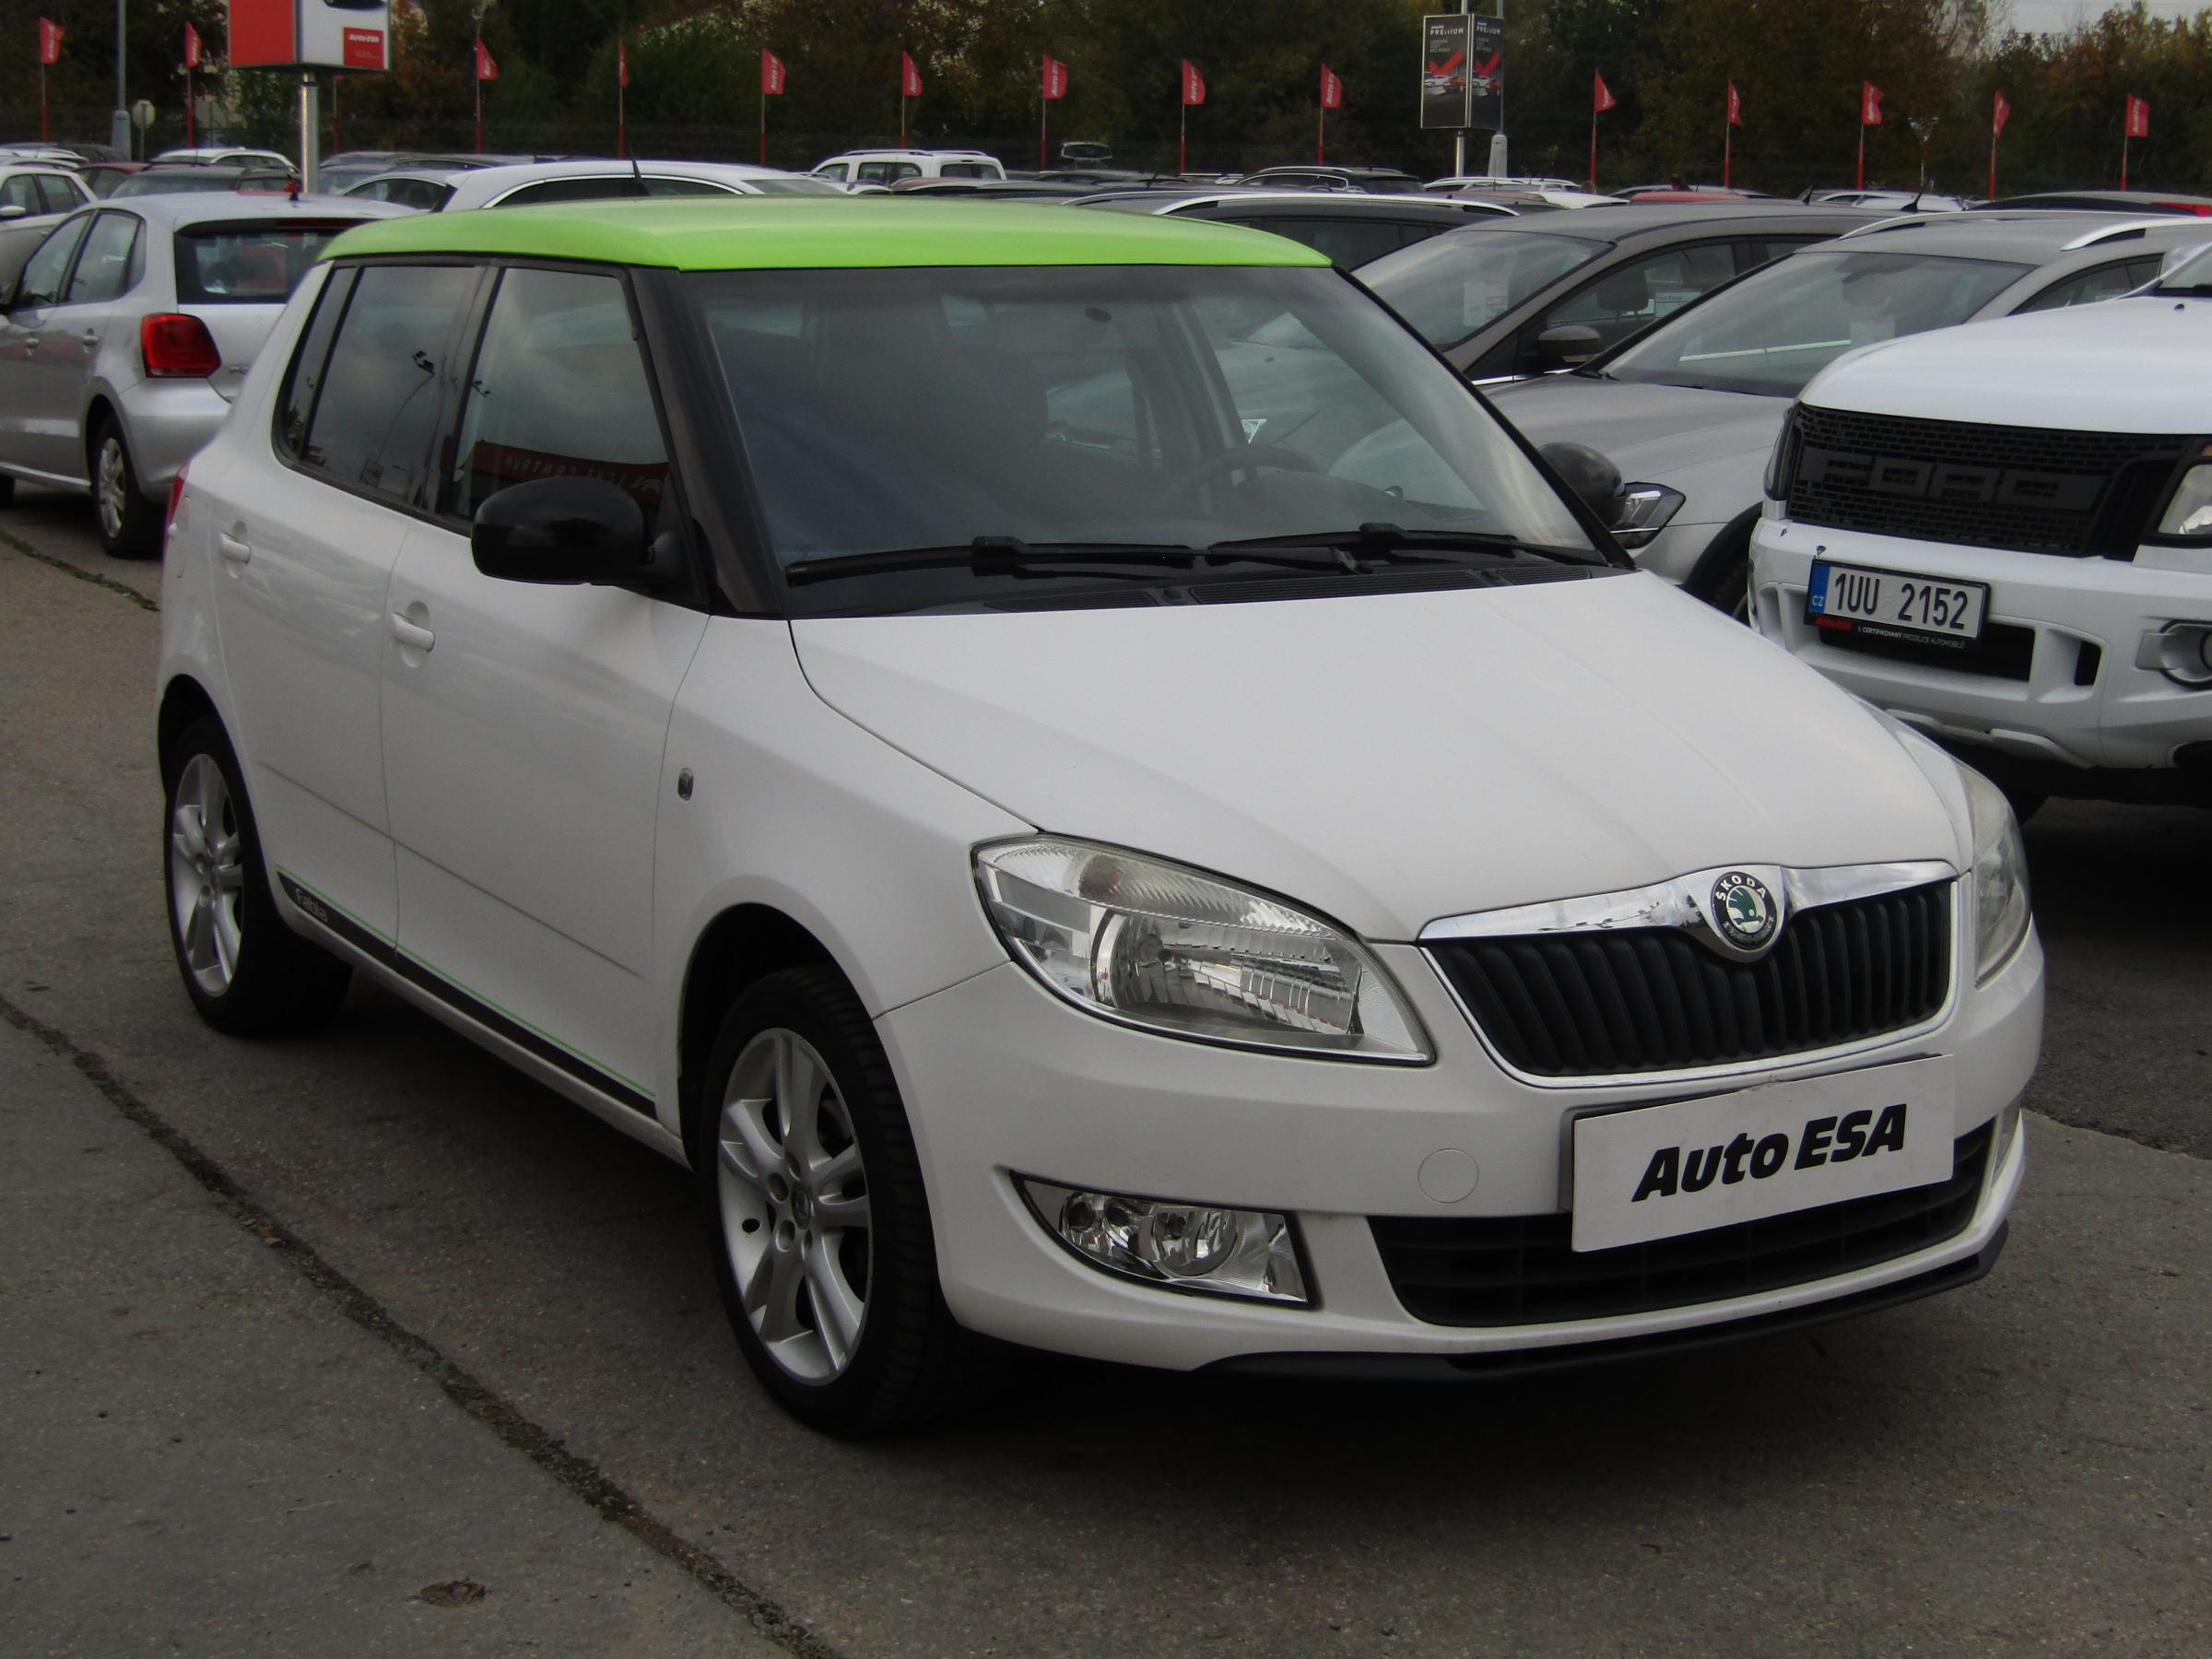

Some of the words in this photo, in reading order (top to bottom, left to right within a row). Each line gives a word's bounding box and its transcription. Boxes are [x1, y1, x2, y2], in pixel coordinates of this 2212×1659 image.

[1797, 447, 2108, 511] FORD
[1812, 594, 1824, 606] CZ
[1835, 573, 1880, 615] 1UU
[1898, 582, 1969, 629] 2152
[1714, 875, 1766, 901] ŠKODA
[1630, 1132, 1791, 1203] Auto
[1794, 1103, 1908, 1171] ESA
